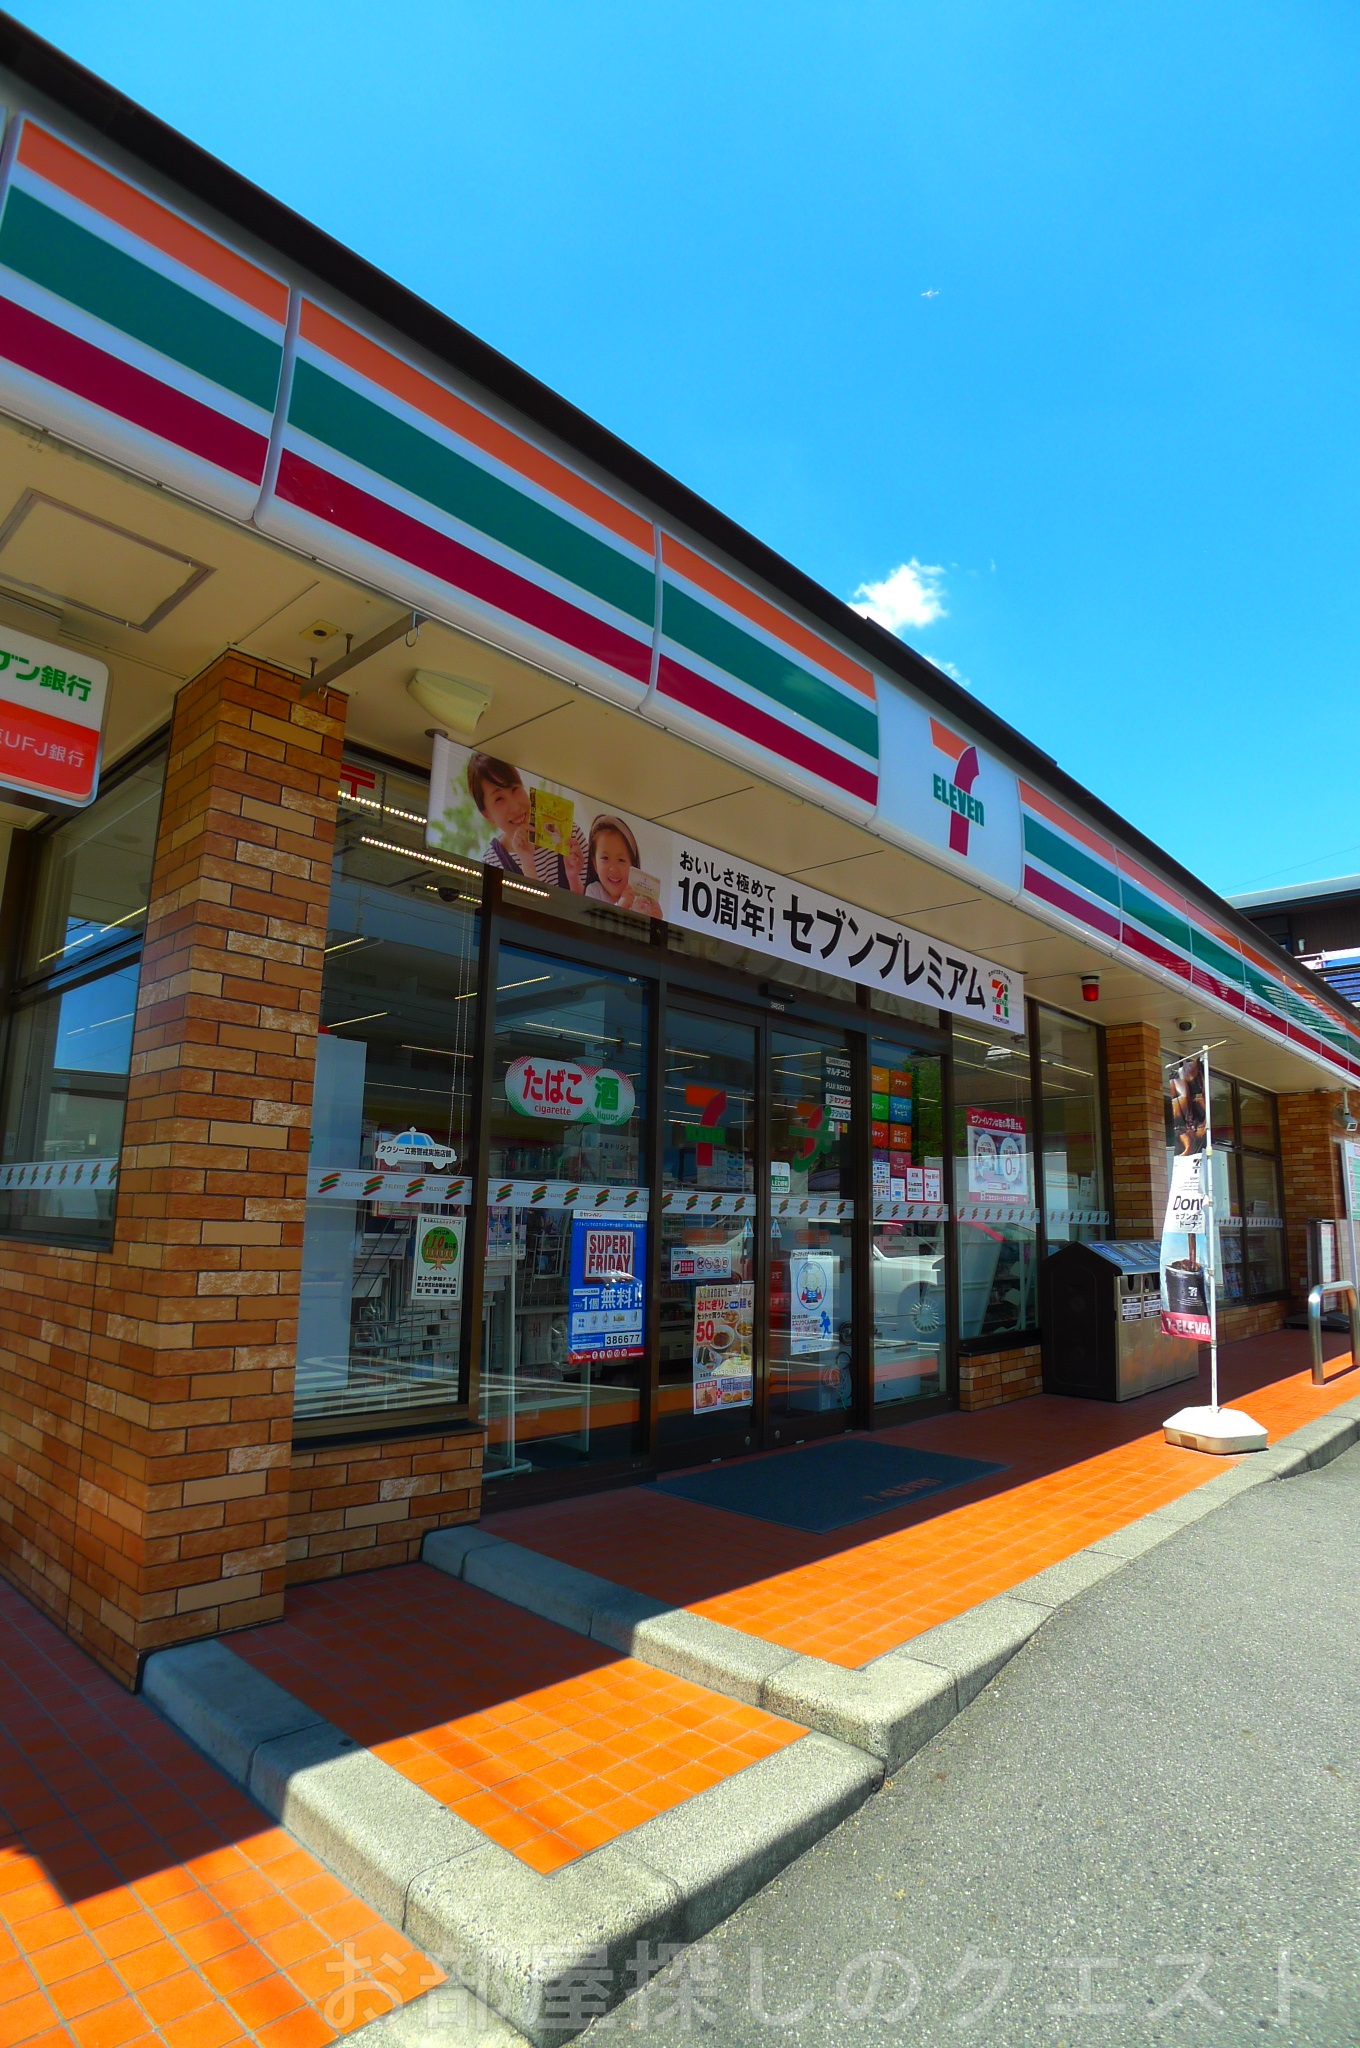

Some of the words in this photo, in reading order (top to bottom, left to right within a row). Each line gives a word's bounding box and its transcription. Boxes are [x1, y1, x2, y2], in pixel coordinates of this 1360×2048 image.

[679, 851, 776, 903] おいしさ極めて
[782, 893, 987, 1011] セブンプレミアム
[522, 1065, 584, 1105] たばこ
[594, 1075, 620, 1111] 酒
[534, 1104, 572, 1116] cigarette
[596, 1110, 620, 1122] liquor
[588, 1254, 631, 1274] FRIDAY
[697, 1311, 725, 1320] セットで買うと
[606, 1334, 641, 1345] 386677
[696, 1320, 715, 1342] 50
